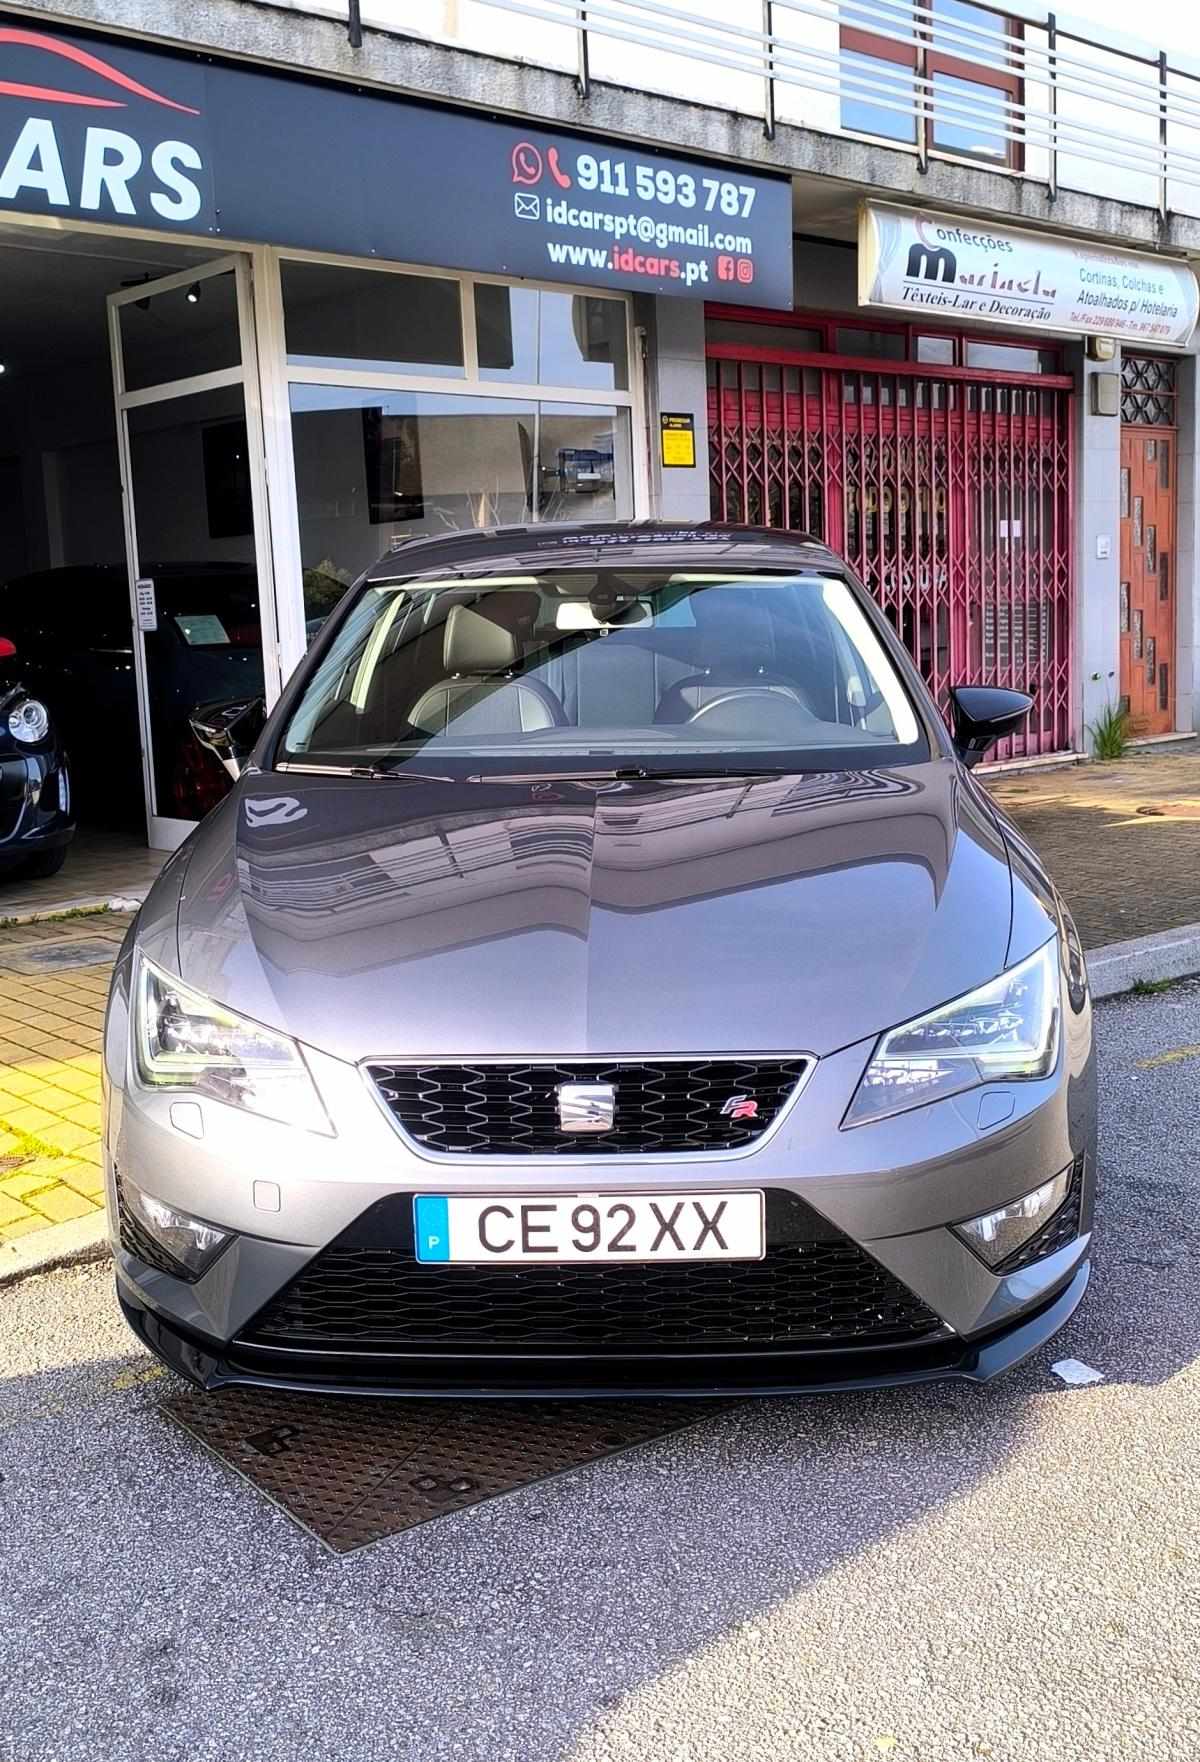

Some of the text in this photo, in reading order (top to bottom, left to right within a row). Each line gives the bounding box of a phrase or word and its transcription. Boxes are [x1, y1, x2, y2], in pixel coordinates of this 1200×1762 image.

[0, 116, 202, 221] ARS
[576, 154, 756, 218] 911 593 787
[546, 198, 752, 254] idcarspt@gmail.com
[547, 243, 709, 286] www.idcars.pt
[1122, 275, 1157, 294] Colchas
[1158, 283, 1164, 295] e
[979, 301, 986, 311] e
[988, 299, 1051, 322] Decoração
[1076, 290, 1129, 311] Atoalhados
[1140, 300, 1178, 318] Hotelaria
[720, 1094, 758, 1118] FR
[428, 1200, 729, 1253] P CE 92 XX
